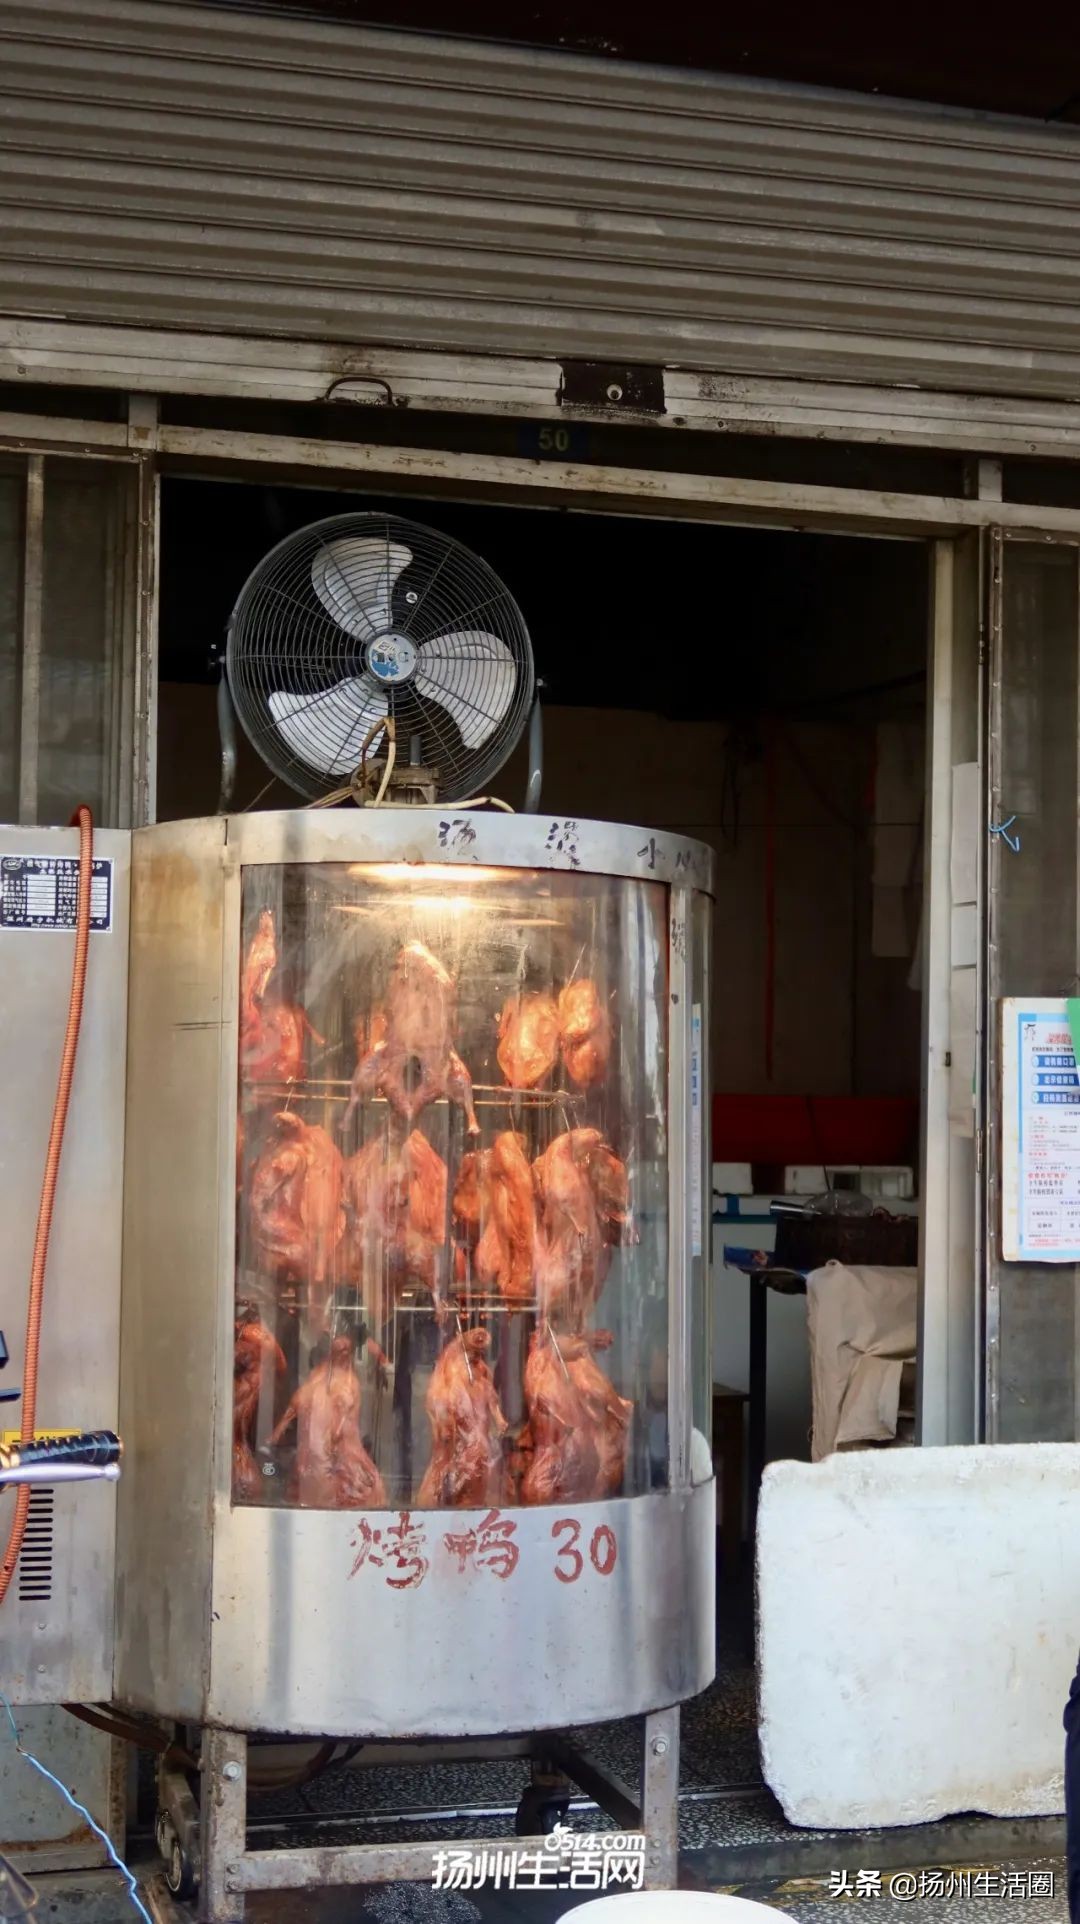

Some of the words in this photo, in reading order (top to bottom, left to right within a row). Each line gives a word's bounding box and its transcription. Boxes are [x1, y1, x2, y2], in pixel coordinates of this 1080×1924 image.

[538, 428, 568, 451] 50
[347, 1508, 519, 1589] 烤鸭
[551, 1518, 617, 1584] 30
